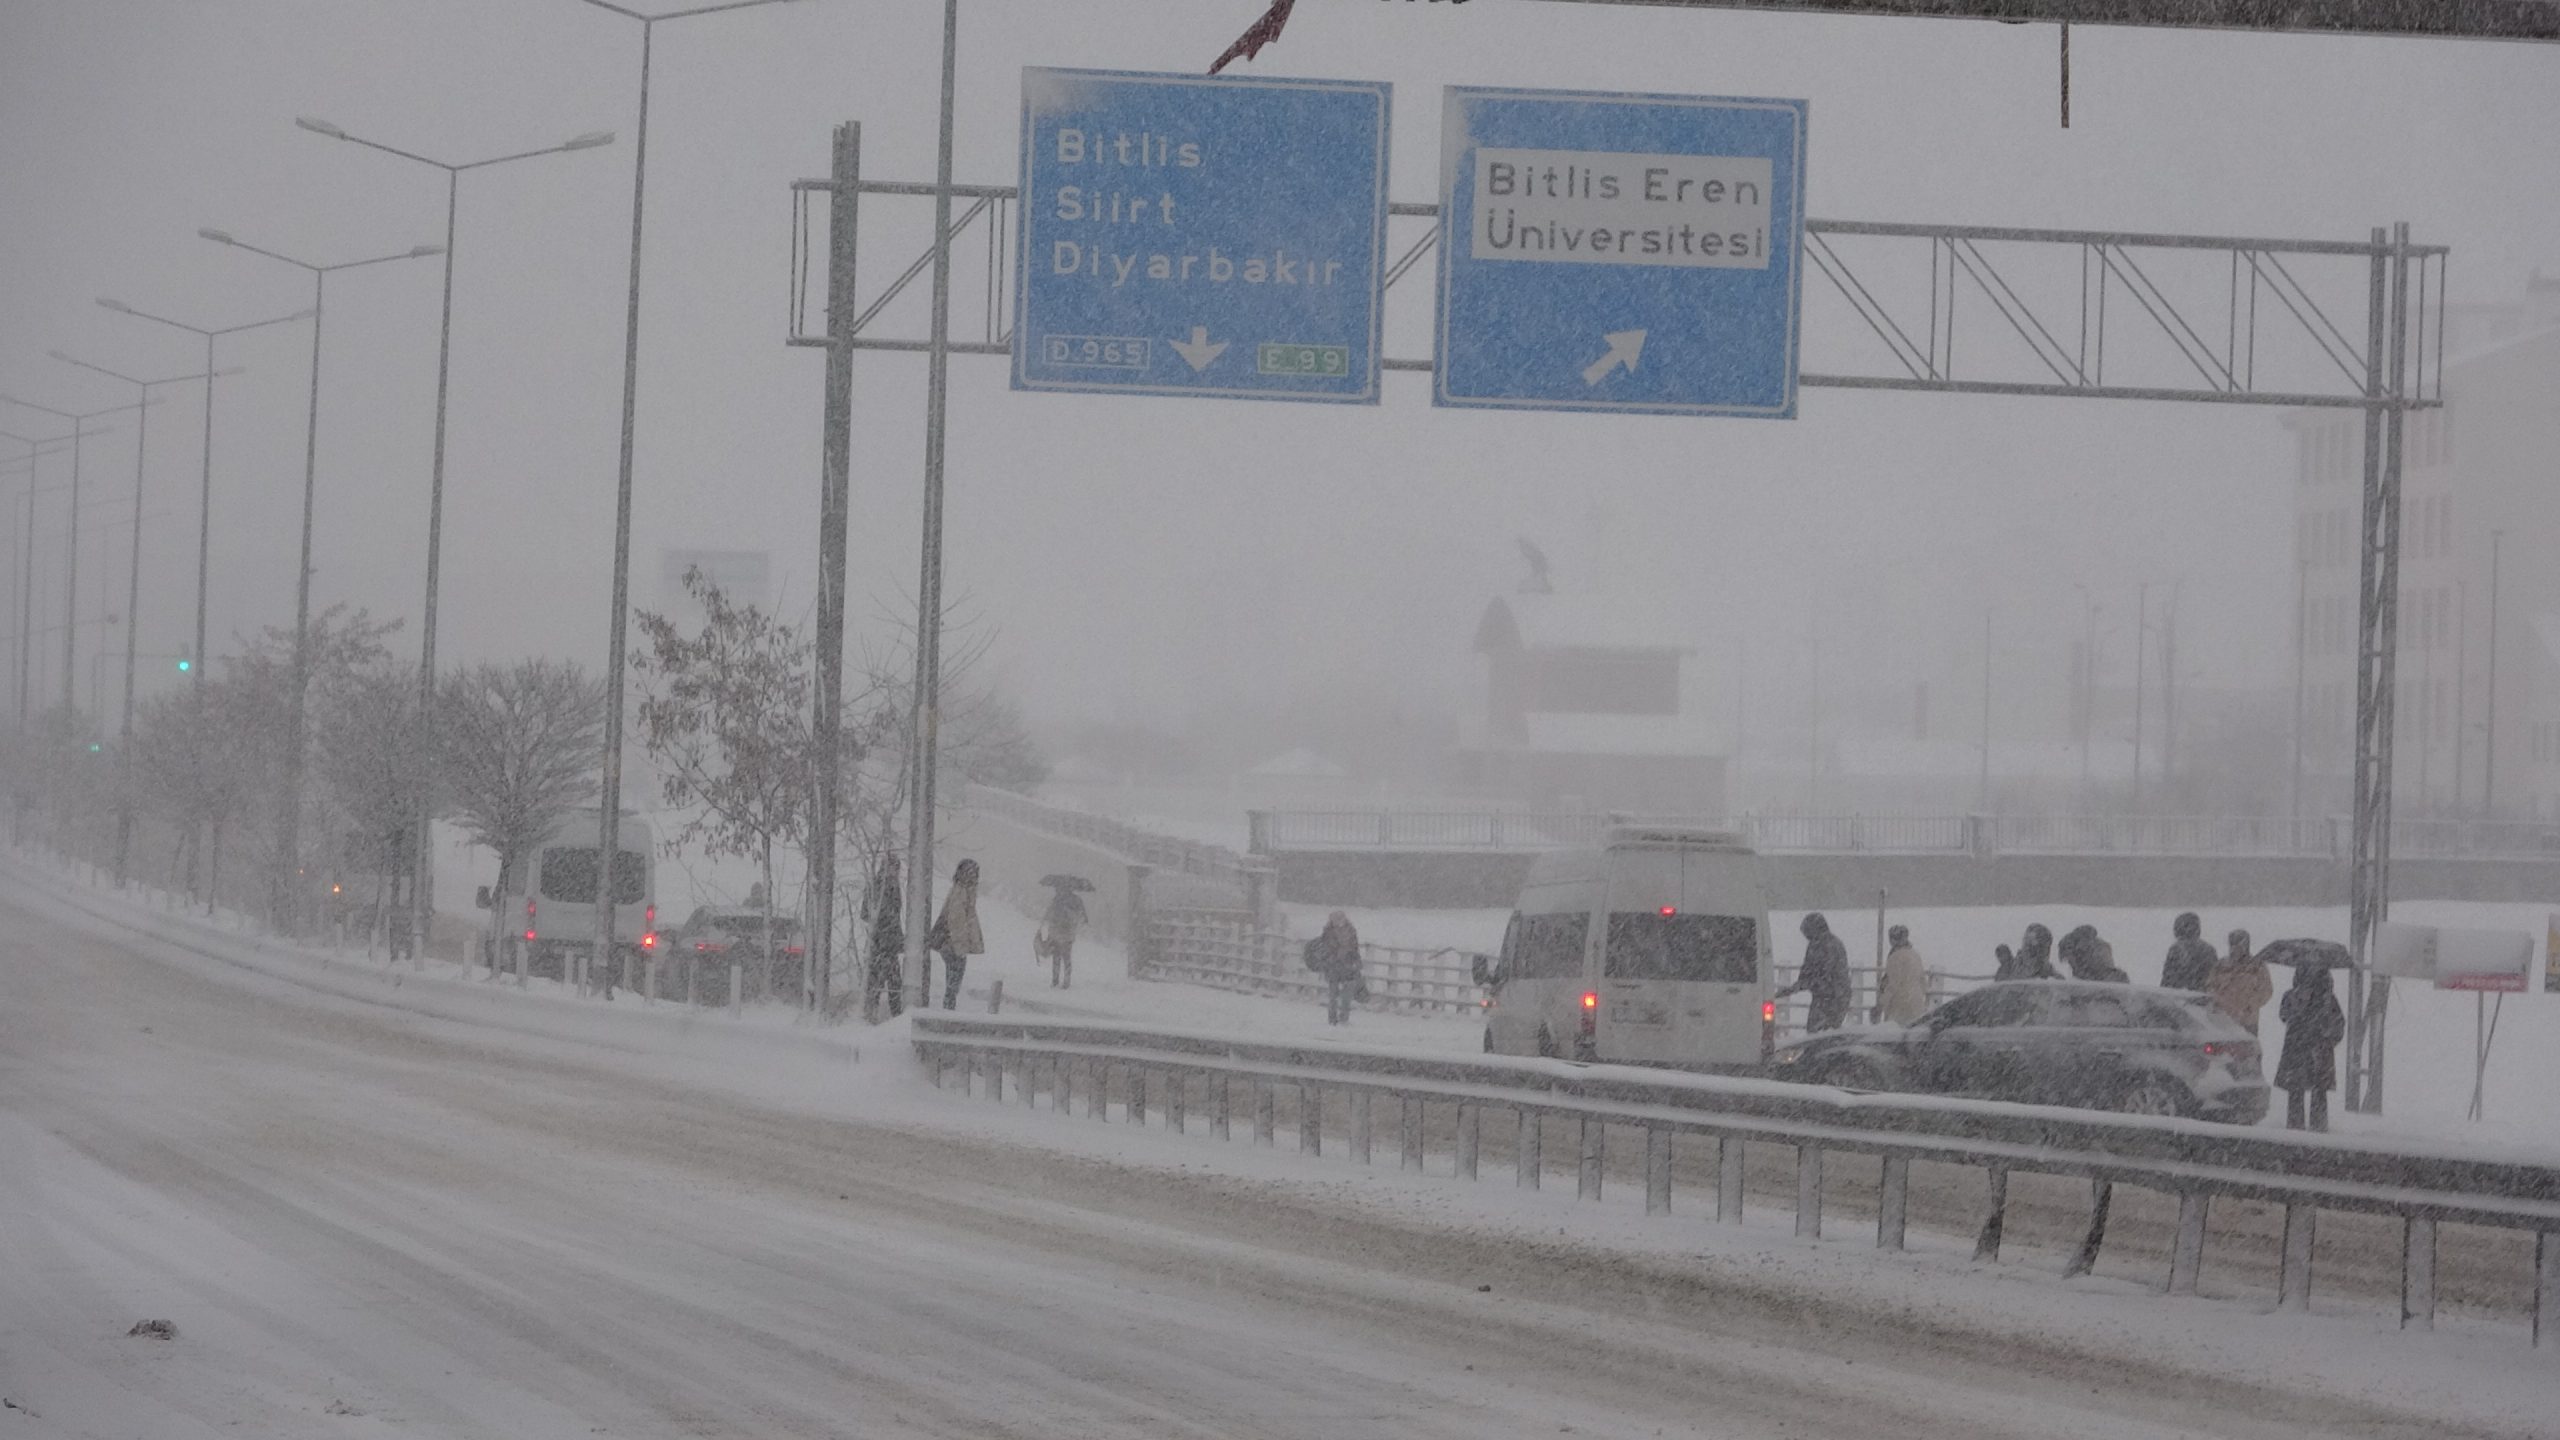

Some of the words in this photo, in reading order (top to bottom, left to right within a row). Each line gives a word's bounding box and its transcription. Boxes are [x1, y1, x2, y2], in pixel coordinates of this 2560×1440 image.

[1057, 129, 1201, 168] Bitlis
[1488, 163, 1620, 200] Bitlis
[1643, 168, 1759, 205] Eren
[1057, 187, 1176, 224] Siirt
[1487, 208, 1763, 258] Üniversitesi
[1053, 242, 1342, 287] Diyarbakır
